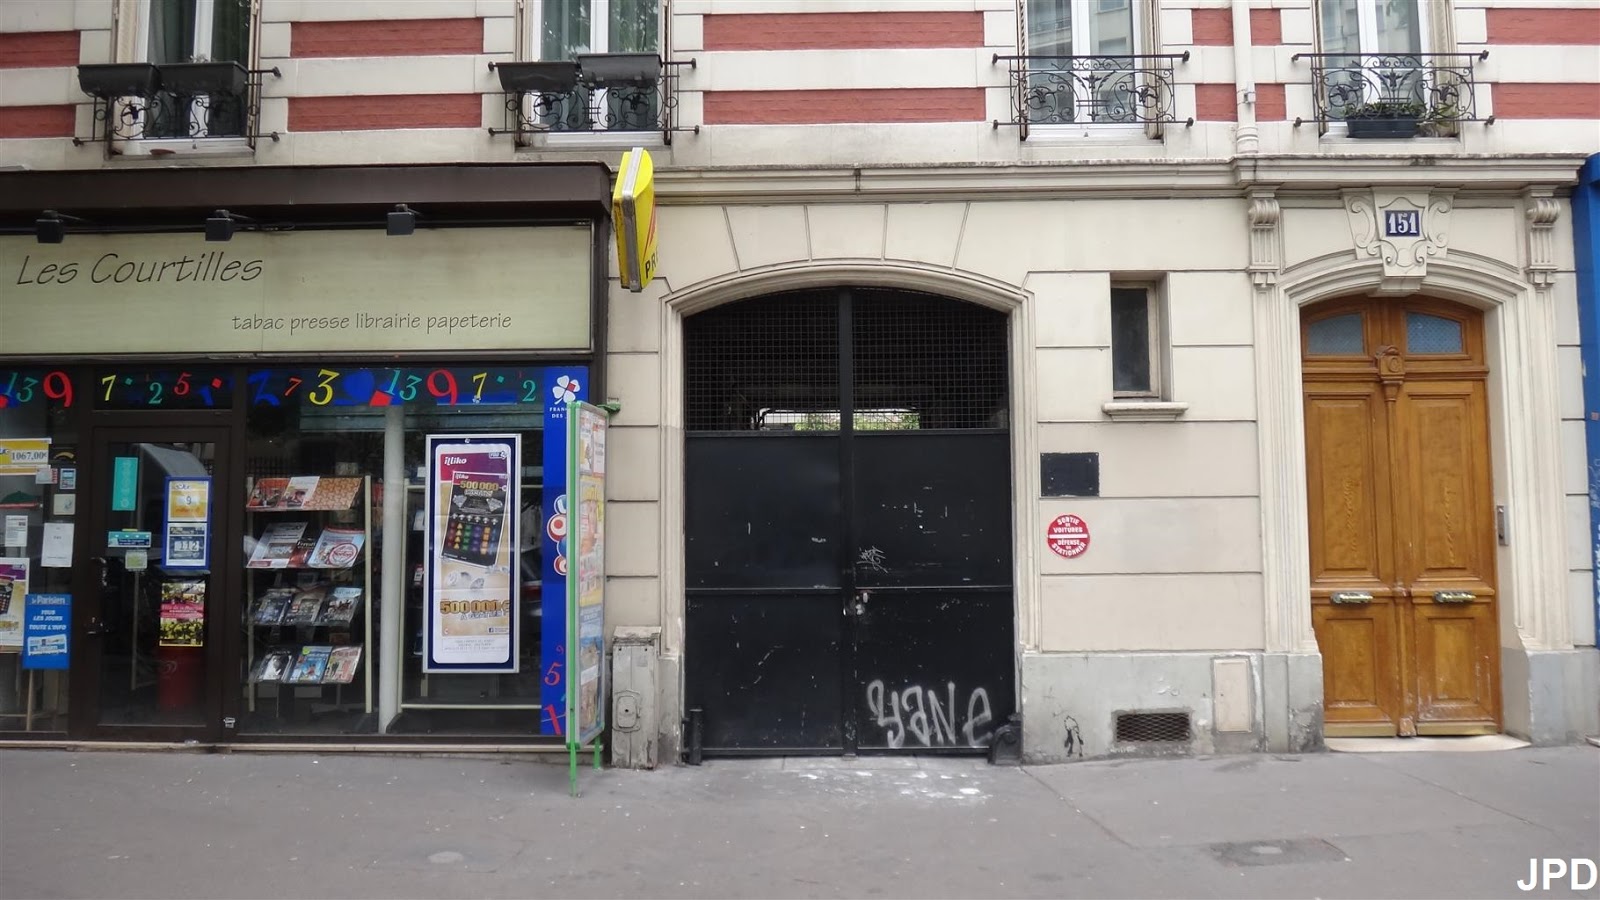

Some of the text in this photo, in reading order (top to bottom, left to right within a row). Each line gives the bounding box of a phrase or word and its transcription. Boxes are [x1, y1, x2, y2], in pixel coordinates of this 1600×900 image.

[1389, 213, 1417, 234] 151
[17, 251, 263, 285] Les Courtilles
[232, 312, 512, 336] tabac presse librairie papeterie
[309, 368, 340, 405] 3
[460, 480, 499, 492] 500 000
[1057, 516, 1080, 526] SORTIE
[1052, 542, 1087, 556] STATIONNER
[440, 599, 470, 615] 500
